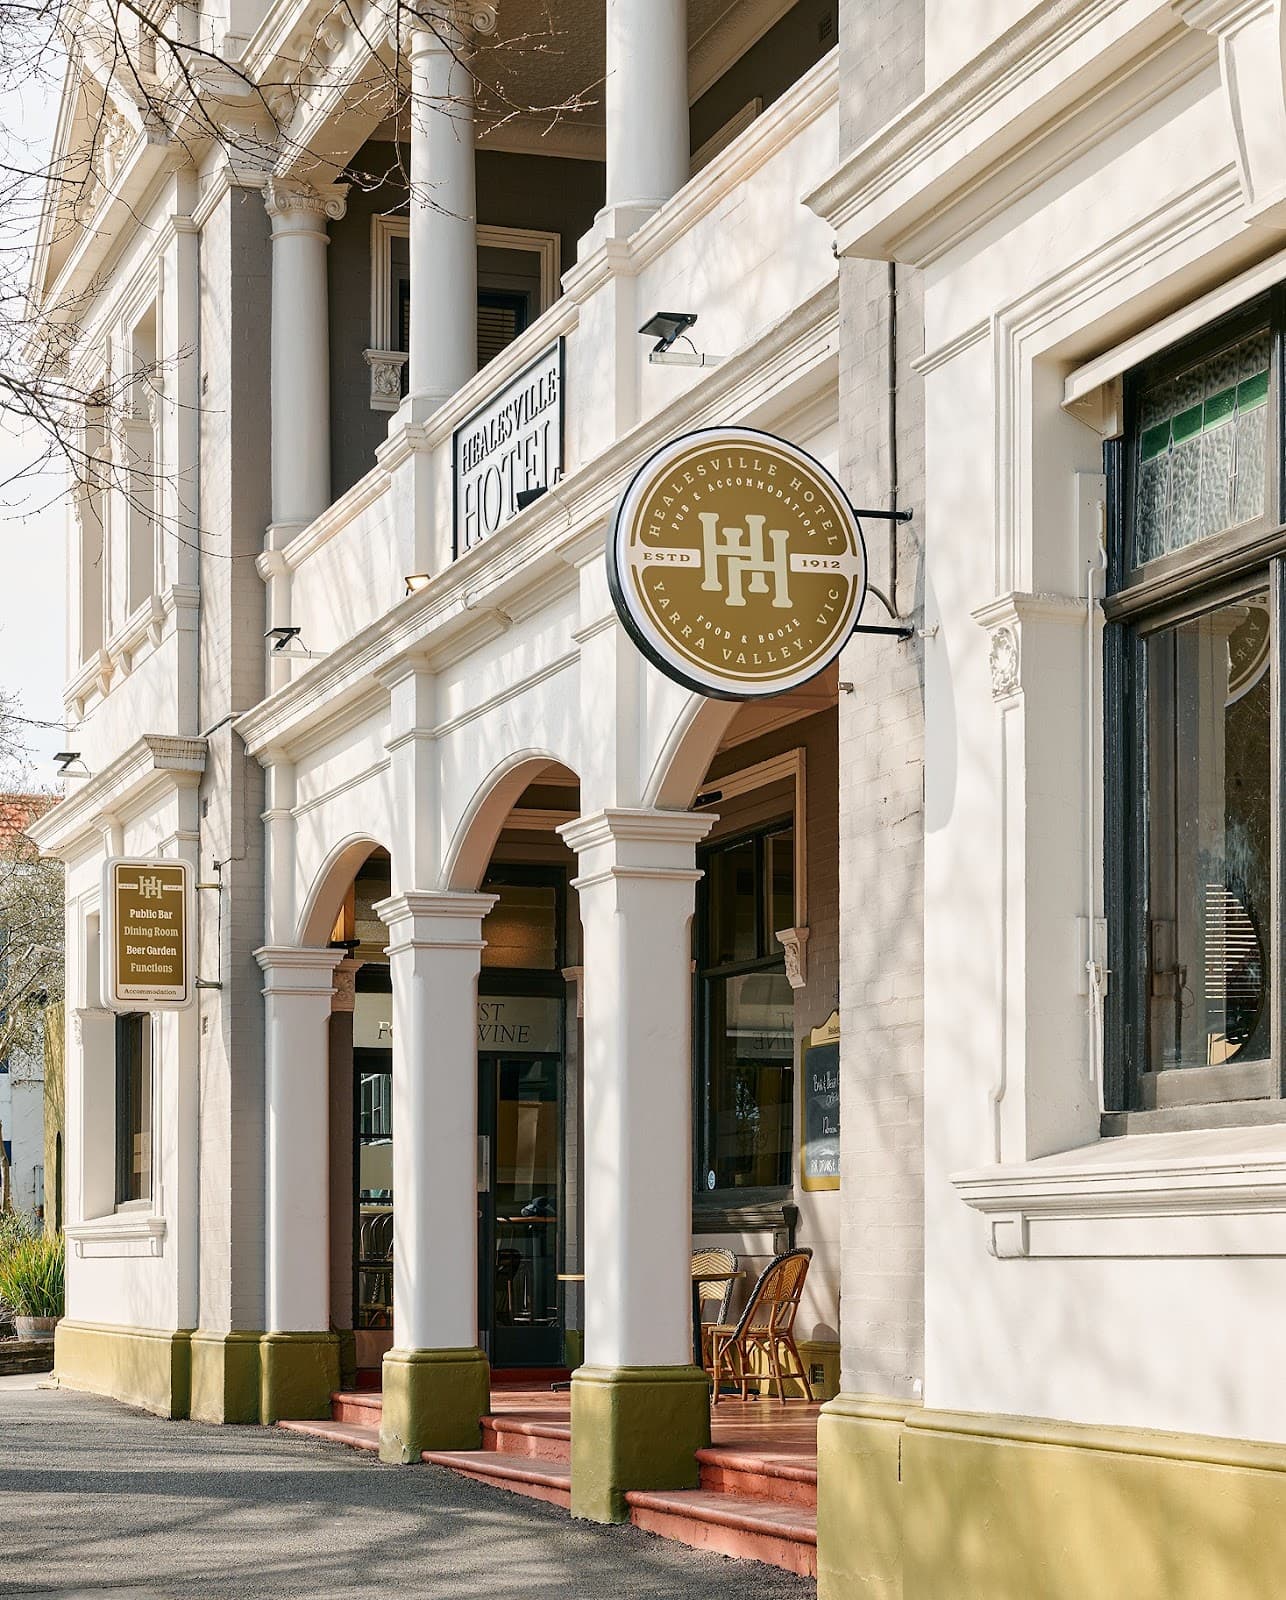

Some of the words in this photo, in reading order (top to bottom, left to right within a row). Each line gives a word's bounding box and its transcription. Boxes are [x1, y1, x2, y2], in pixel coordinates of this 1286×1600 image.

[462, 368, 557, 476] HEALESVILLE
[463, 420, 562, 554] HOTEL
[649, 457, 777, 537] HEALESVILLE
[789, 478, 838, 545] HOTEL
[672, 504, 689, 530] PUB
[693, 492, 701, 501] &
[708, 478, 817, 537] ACCOMMODATION
[643, 553, 691, 562] ESTD
[801, 560, 841, 569] 1912
[654, 581, 706, 650] YARRA
[722, 638, 813, 665] VALLEY,
[816, 589, 839, 627] VIC
[696, 615, 731, 640] FOOD
[741, 634, 748, 643] &
[758, 618, 801, 643] BOOZE
[129, 909, 157, 919] Public
[158, 910, 173, 919] Bar
[124, 926, 153, 938] Dining
[154, 927, 178, 937] Room
[126, 945, 145, 955] Beer
[146, 946, 176, 956] Garden
[130, 963, 173, 973] Functions
